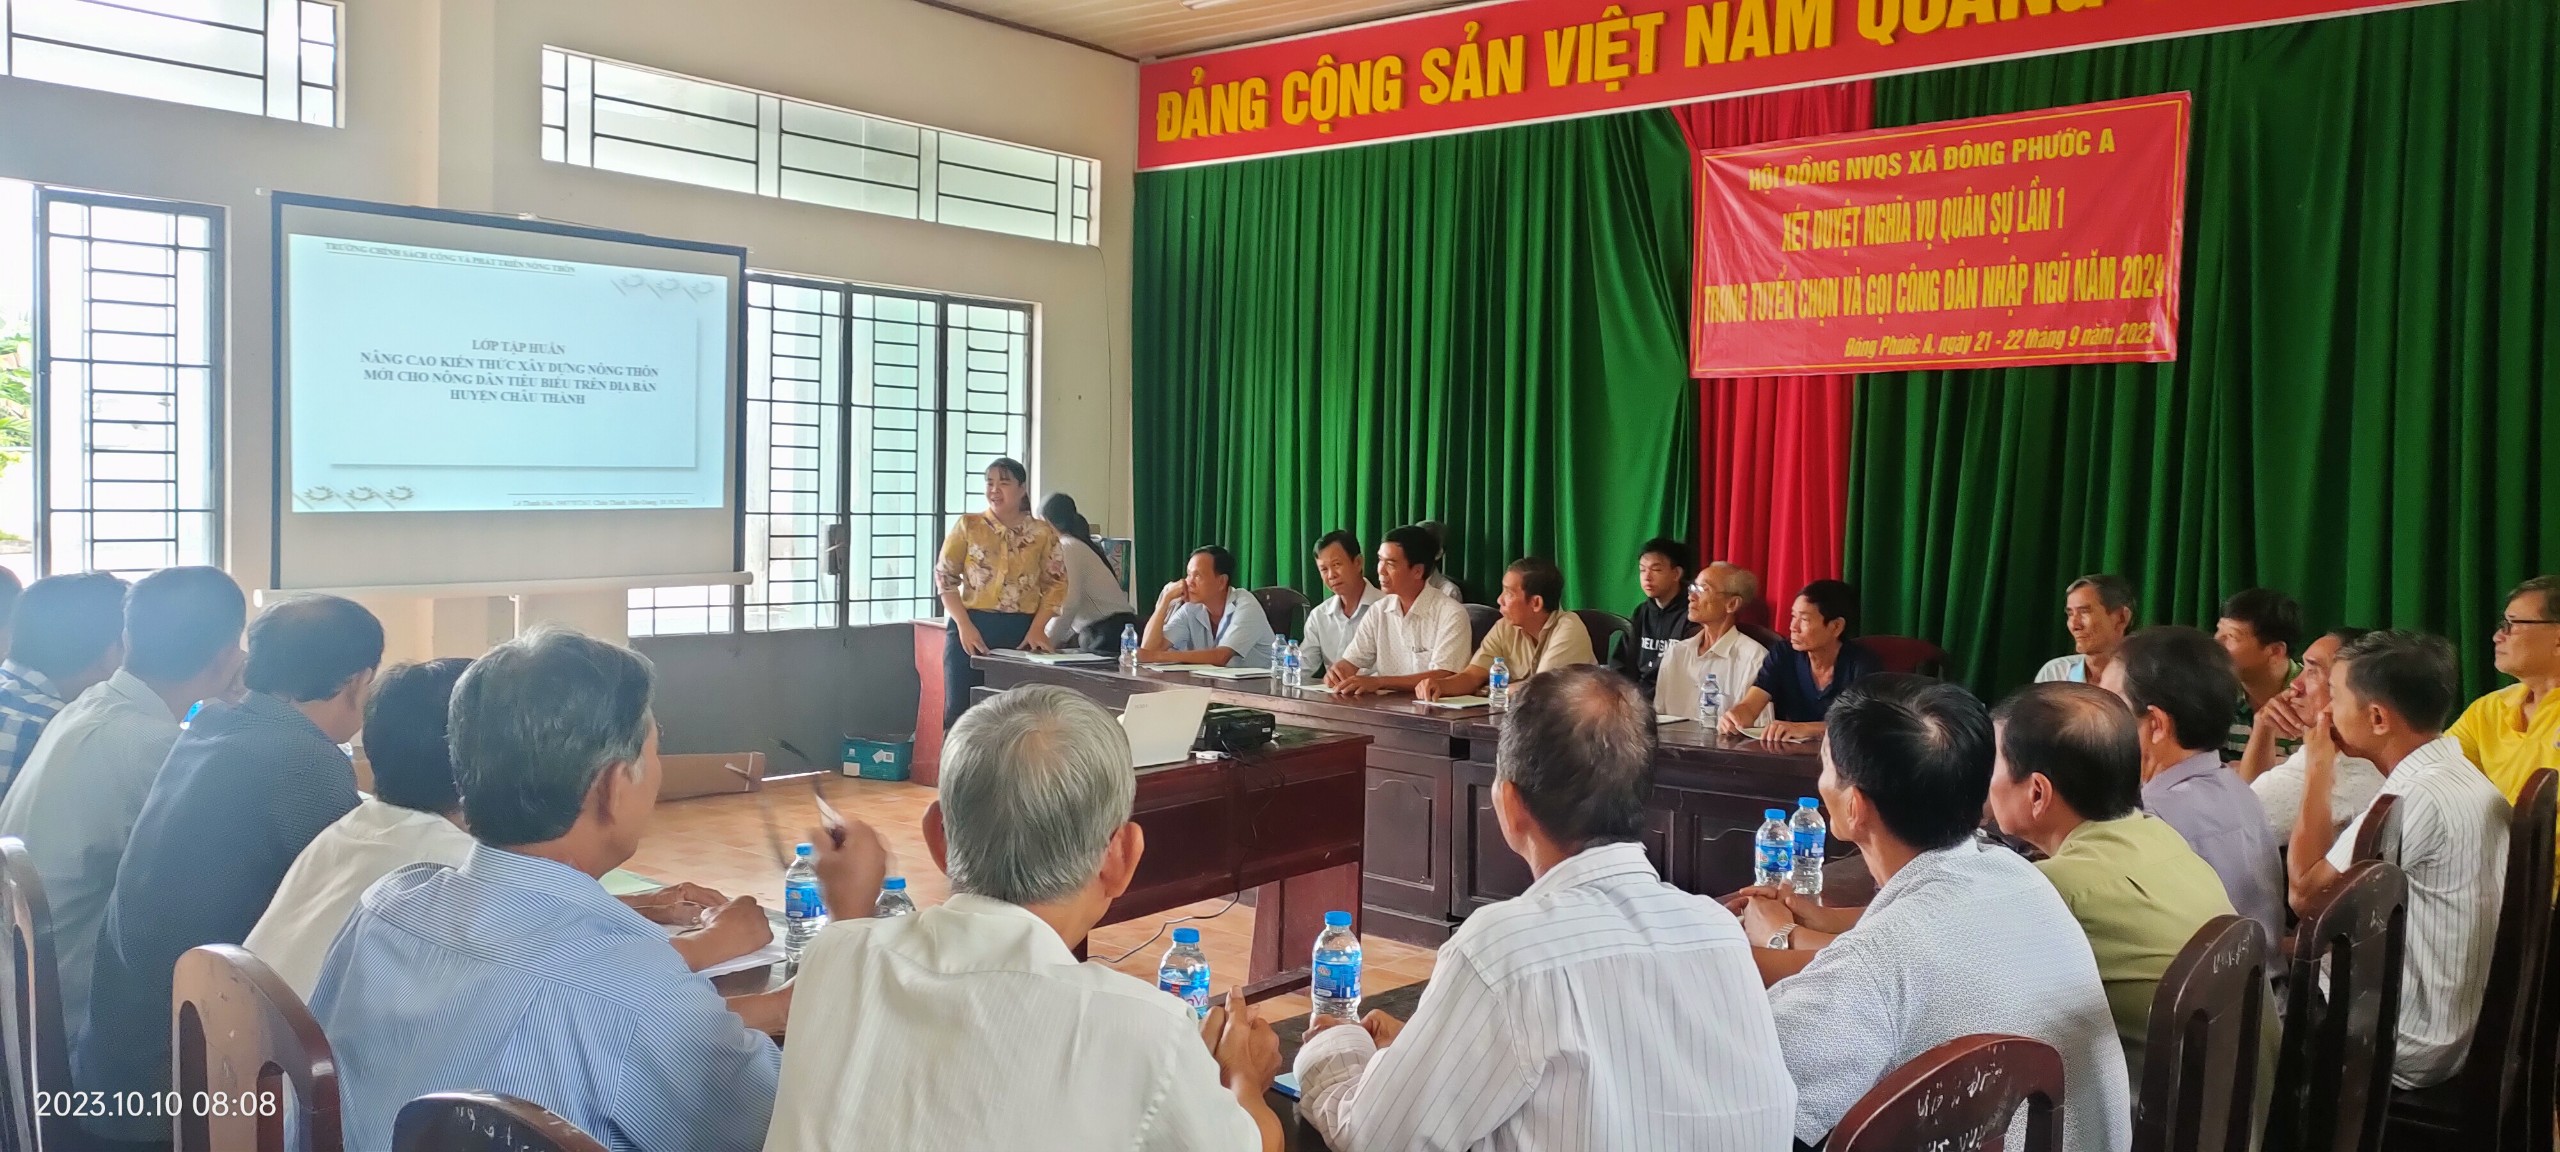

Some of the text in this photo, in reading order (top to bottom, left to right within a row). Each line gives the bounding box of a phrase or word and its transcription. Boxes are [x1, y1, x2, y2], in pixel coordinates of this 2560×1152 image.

[1156, 66, 1267, 142] ĐẢNG
[1280, 54, 1402, 132] CỘNG
[1419, 21, 1524, 104] SẢN
[1544, 8, 1665, 94] VIỆT
[1684, 0, 1835, 67] NAM
[1748, 128, 2115, 195] HỘI ĐỒNG NVQS XÃ ĐÔNG PHƯỚC A
[1781, 175, 2065, 256] XÉT DUYỆT NGHĨA VỤ QUÂN SỰ LẦN 1
[1751, 264, 1796, 321] TUYỂN
[1798, 277, 1839, 327] CHỌN
[1843, 266, 1862, 316] VÀ
[1866, 273, 1892, 324] GỌI
[1896, 262, 1941, 313] CÔNG
[1943, 258, 1978, 311] DÂN
[1982, 255, 2028, 317] NHẬP
[2033, 251, 2071, 305] NGŨ
[2074, 248, 2117, 302] NĂM
[2120, 253, 2164, 299] 2024
[360, 349, 402, 365] NÂNG
[406, 354, 437, 366] CAO
[1974, 331, 1992, 351] 21
[2003, 329, 2023, 351] 22
[2024, 325, 2065, 350] tháng
[2068, 326, 2080, 347] 9
[2116, 322, 2157, 345] 2023
[397, 371, 429, 382] CHO
[432, 369, 473, 385] NÔNG
